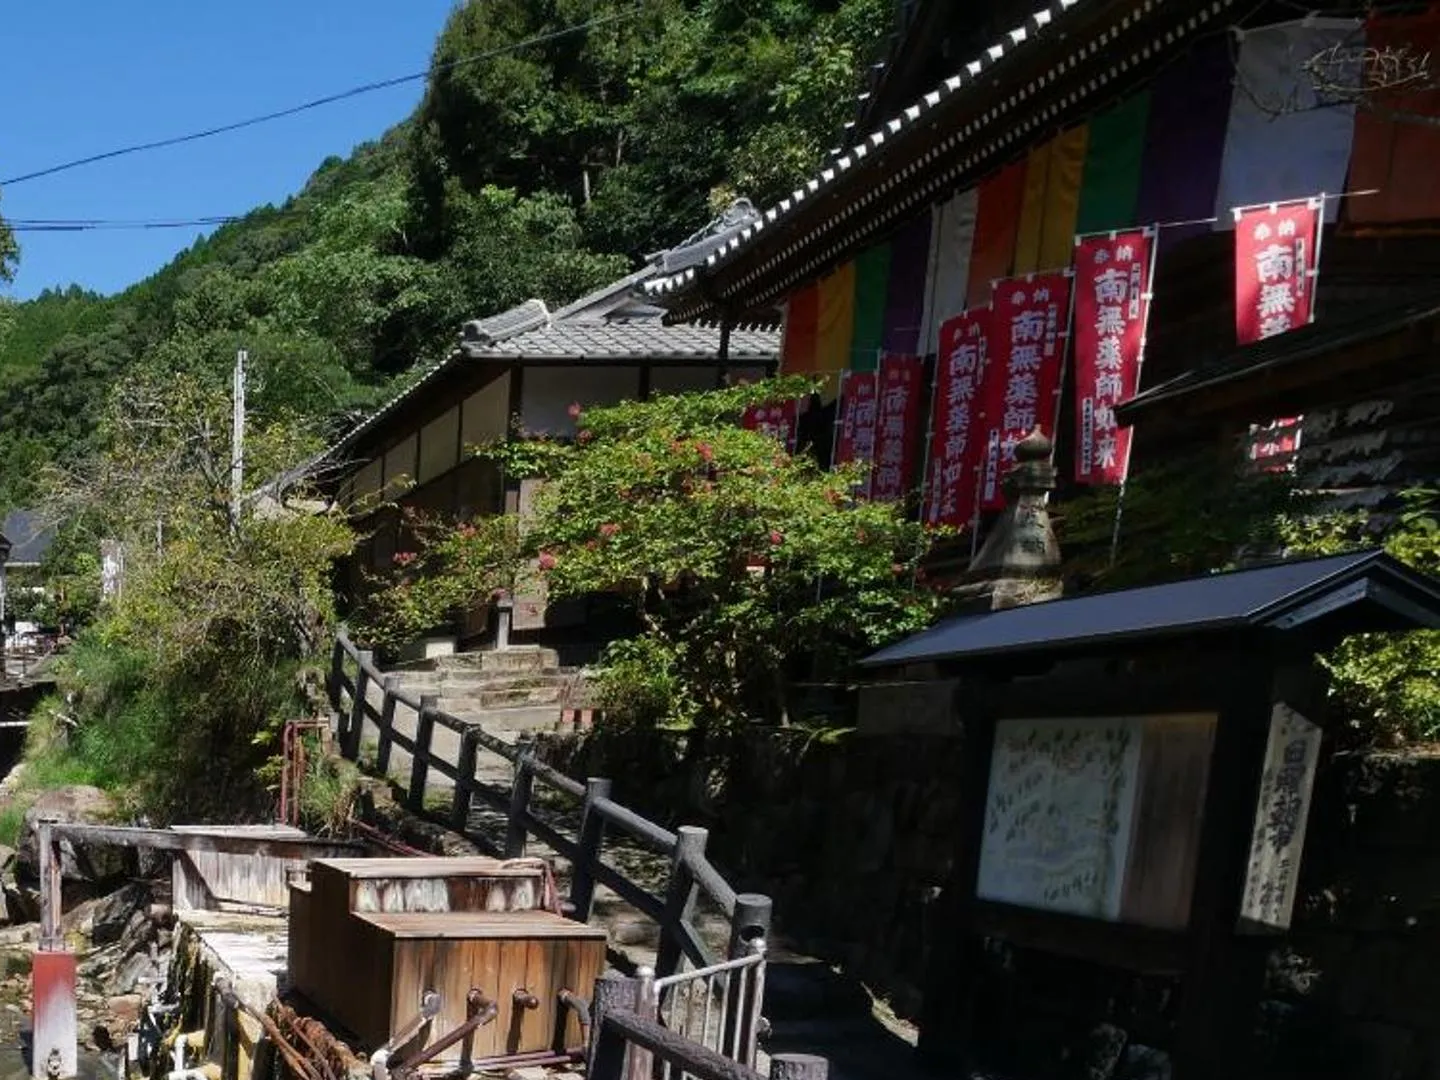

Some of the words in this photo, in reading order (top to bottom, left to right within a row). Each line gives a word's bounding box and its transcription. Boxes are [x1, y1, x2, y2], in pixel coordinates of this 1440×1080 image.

[1093, 267, 1129, 470] 南無薬師如来
